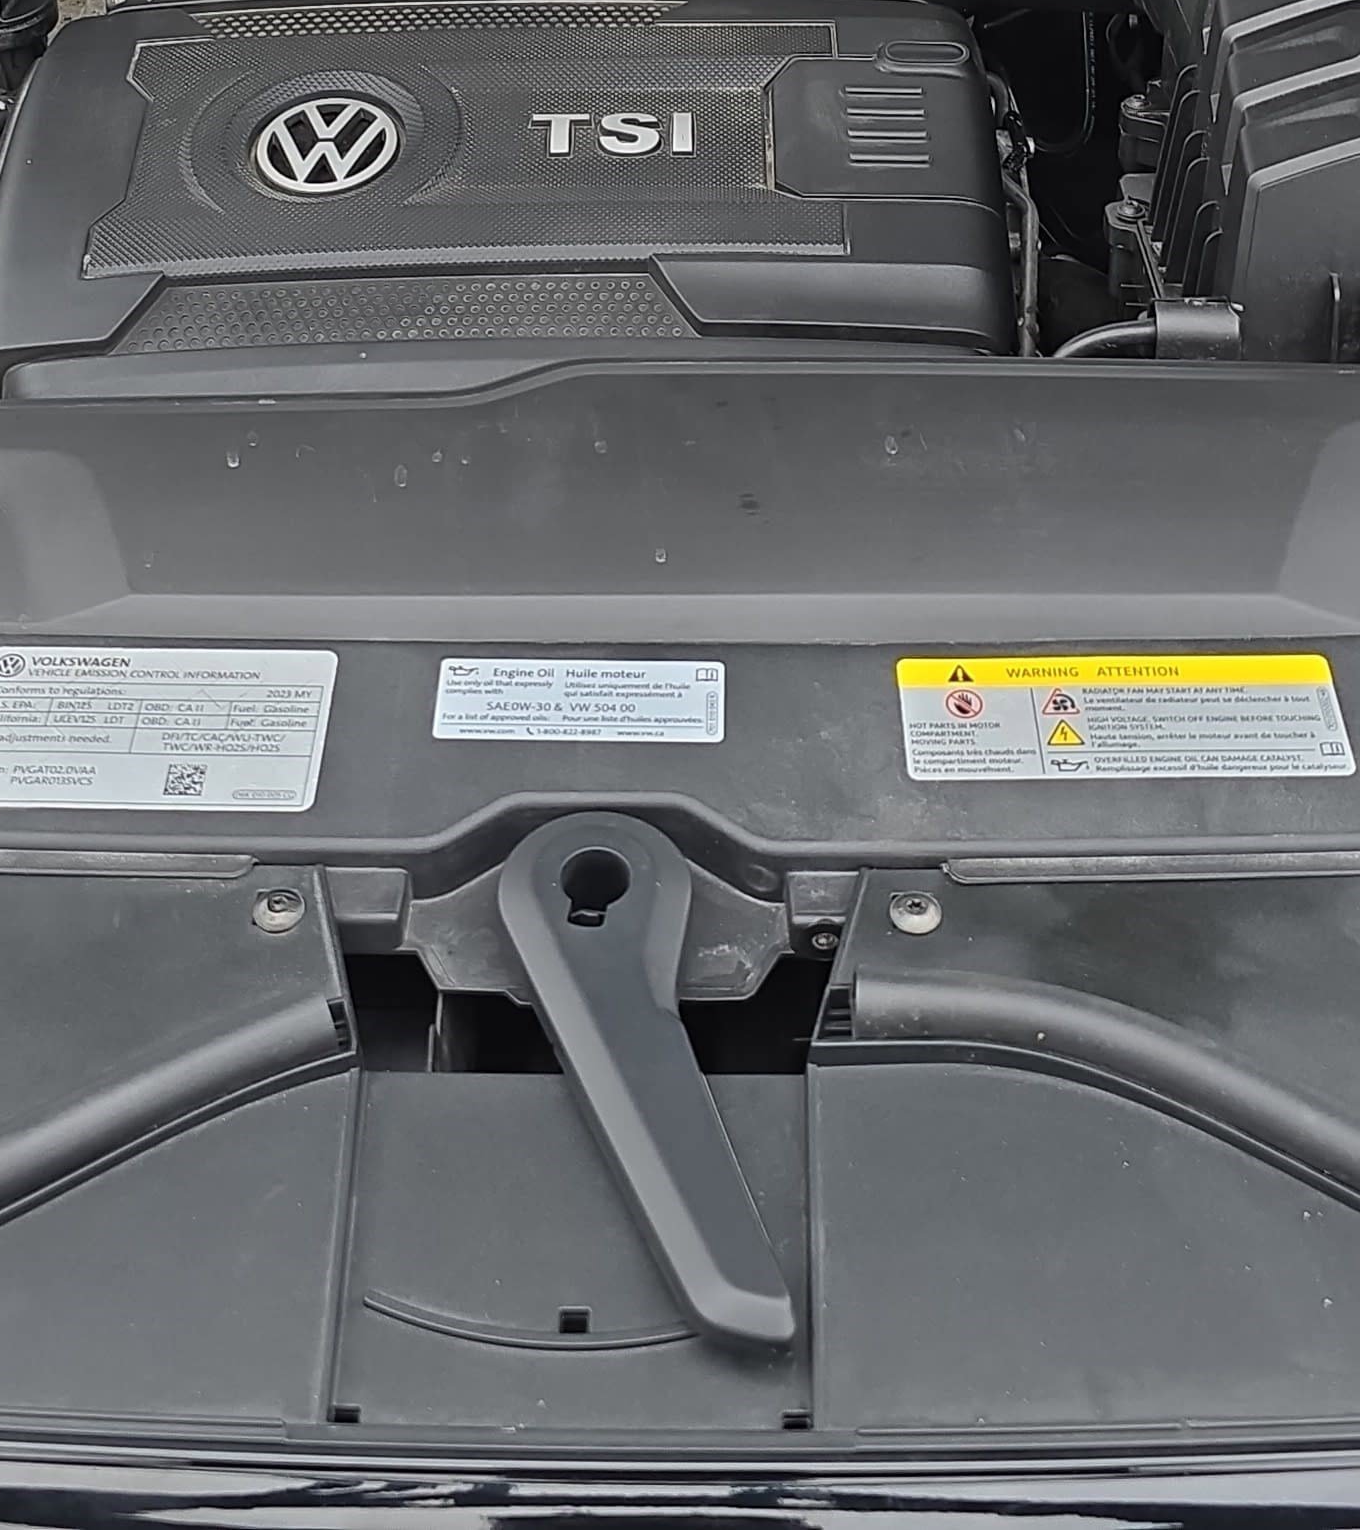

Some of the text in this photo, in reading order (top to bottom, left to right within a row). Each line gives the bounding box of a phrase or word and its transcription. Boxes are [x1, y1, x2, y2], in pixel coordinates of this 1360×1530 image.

[530, 111, 696, 157] TSI
[30, 656, 131, 668] VOLKSWAGEN
[27, 668, 261, 681] VEHICLE EMISSION CONTROL INFORMATION
[493, 667, 647, 679] Engine Oil Huile moteur
[1006, 666, 1180, 678] WARNING ATTENTION
[48, 687, 60, 695] to
[62, 687, 126, 698] regulations:
[266, 689, 292, 699] 2023
[295, 689, 313, 699] MY
[107, 702, 134, 711] LDT2
[144, 703, 171, 712] OBD:
[178, 703, 194, 712] CA
[232, 704, 257, 714] Fuel:
[263, 704, 310, 715] Gasoline
[553, 702, 563, 712] &
[569, 702, 591, 712] VW
[594, 703, 617, 713] 504
[619, 703, 636, 713] 00
[103, 715, 125, 724] LDT
[141, 716, 169, 726] OBD:
[174, 717, 191, 726] CA
[261, 718, 308, 729] Gasoline
[490, 714, 530, 722] approved
[69, 734, 113, 745] needed.
[912, 749, 964, 757] Composants
[1016, 748, 1037, 756] dans
